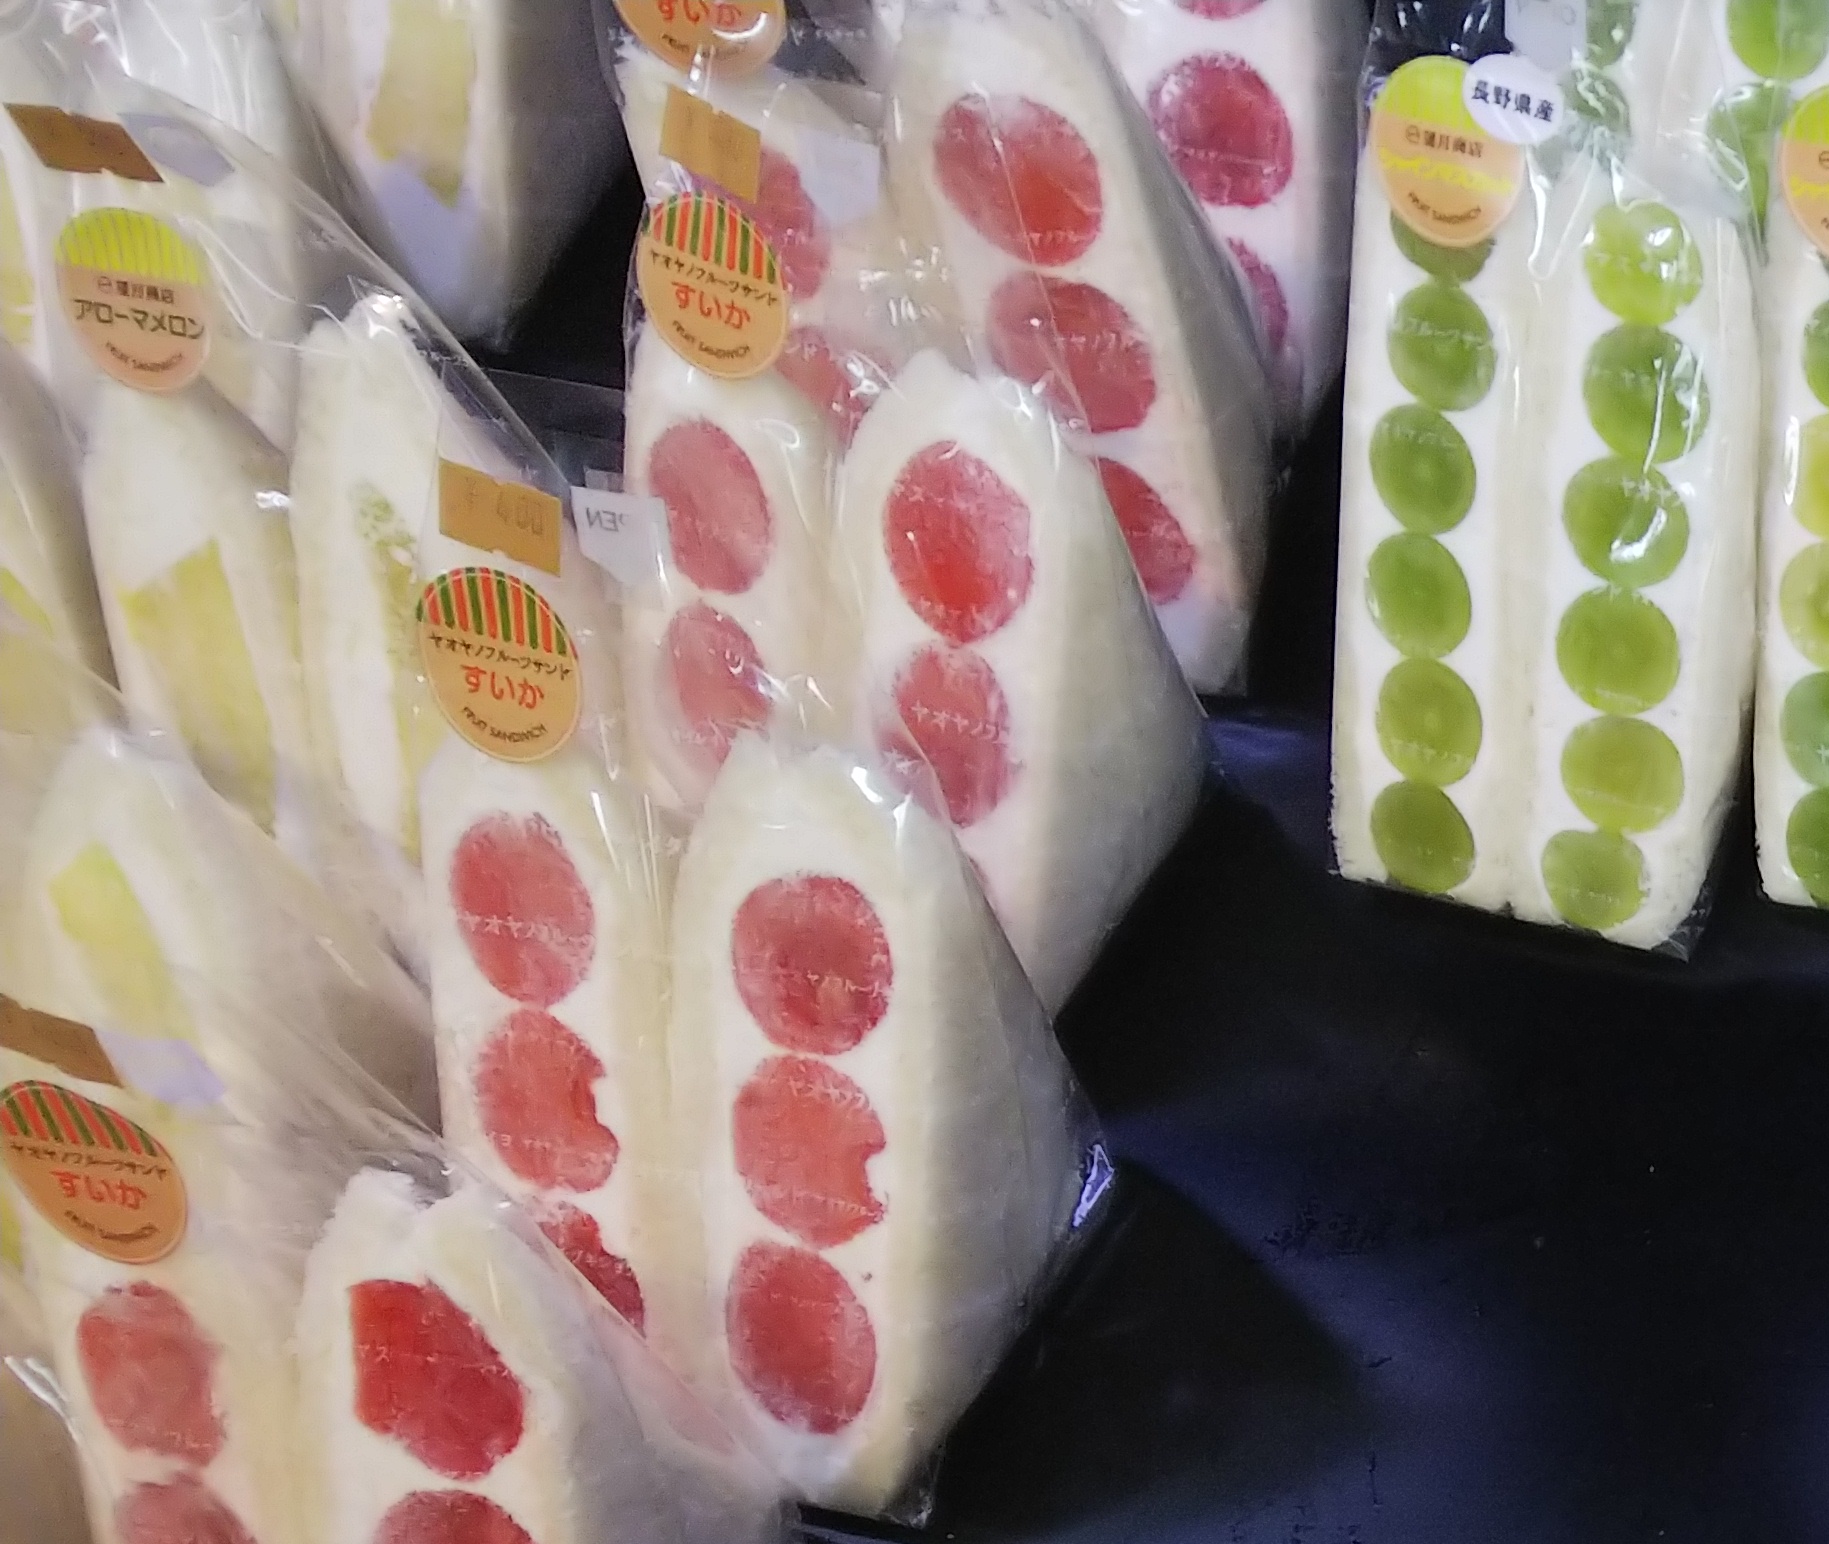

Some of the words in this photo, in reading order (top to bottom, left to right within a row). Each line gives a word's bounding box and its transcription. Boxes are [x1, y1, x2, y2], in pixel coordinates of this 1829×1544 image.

[1471, 79, 1554, 123] 長野県産
[73, 299, 205, 340] アローマメロン
[671, 280, 751, 329] すいか
[428, 632, 572, 681] ヤオヤノフルーツサンド
[460, 664, 545, 709] すいか
[50, 1170, 148, 1210] すいか
